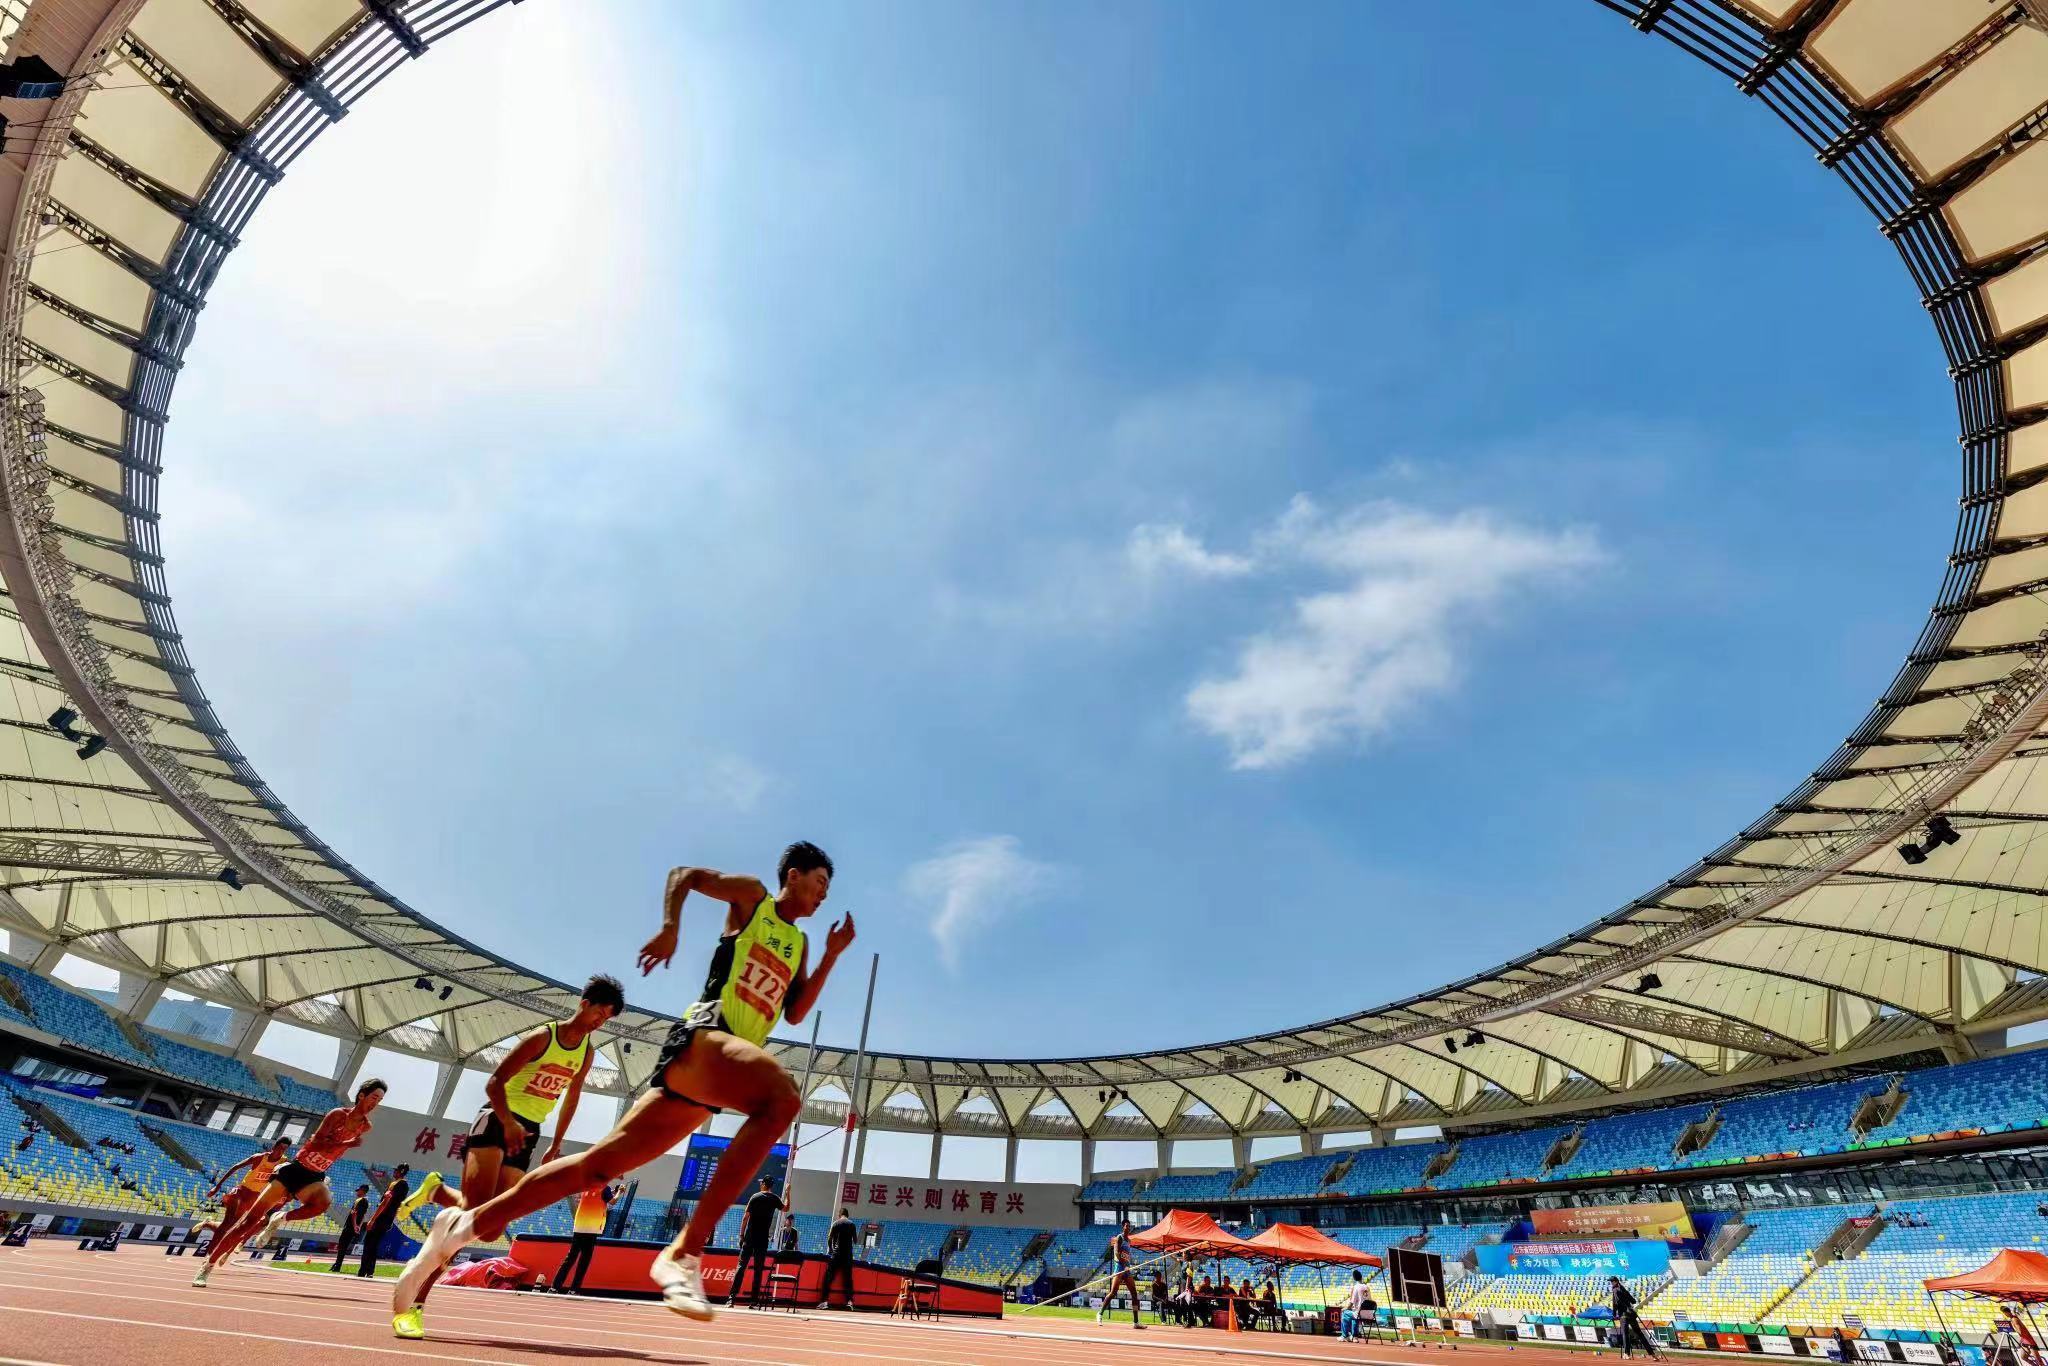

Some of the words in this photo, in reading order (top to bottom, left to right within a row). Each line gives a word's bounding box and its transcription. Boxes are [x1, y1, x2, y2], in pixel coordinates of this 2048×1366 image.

[842, 1182, 1025, 1214] 国运兴则体育兴
[13, 1224, 28, 1238] 4
[106, 1232, 118, 1244] 3
[201, 1240, 210, 1250] 2
[279, 1246, 287, 1256] 1
